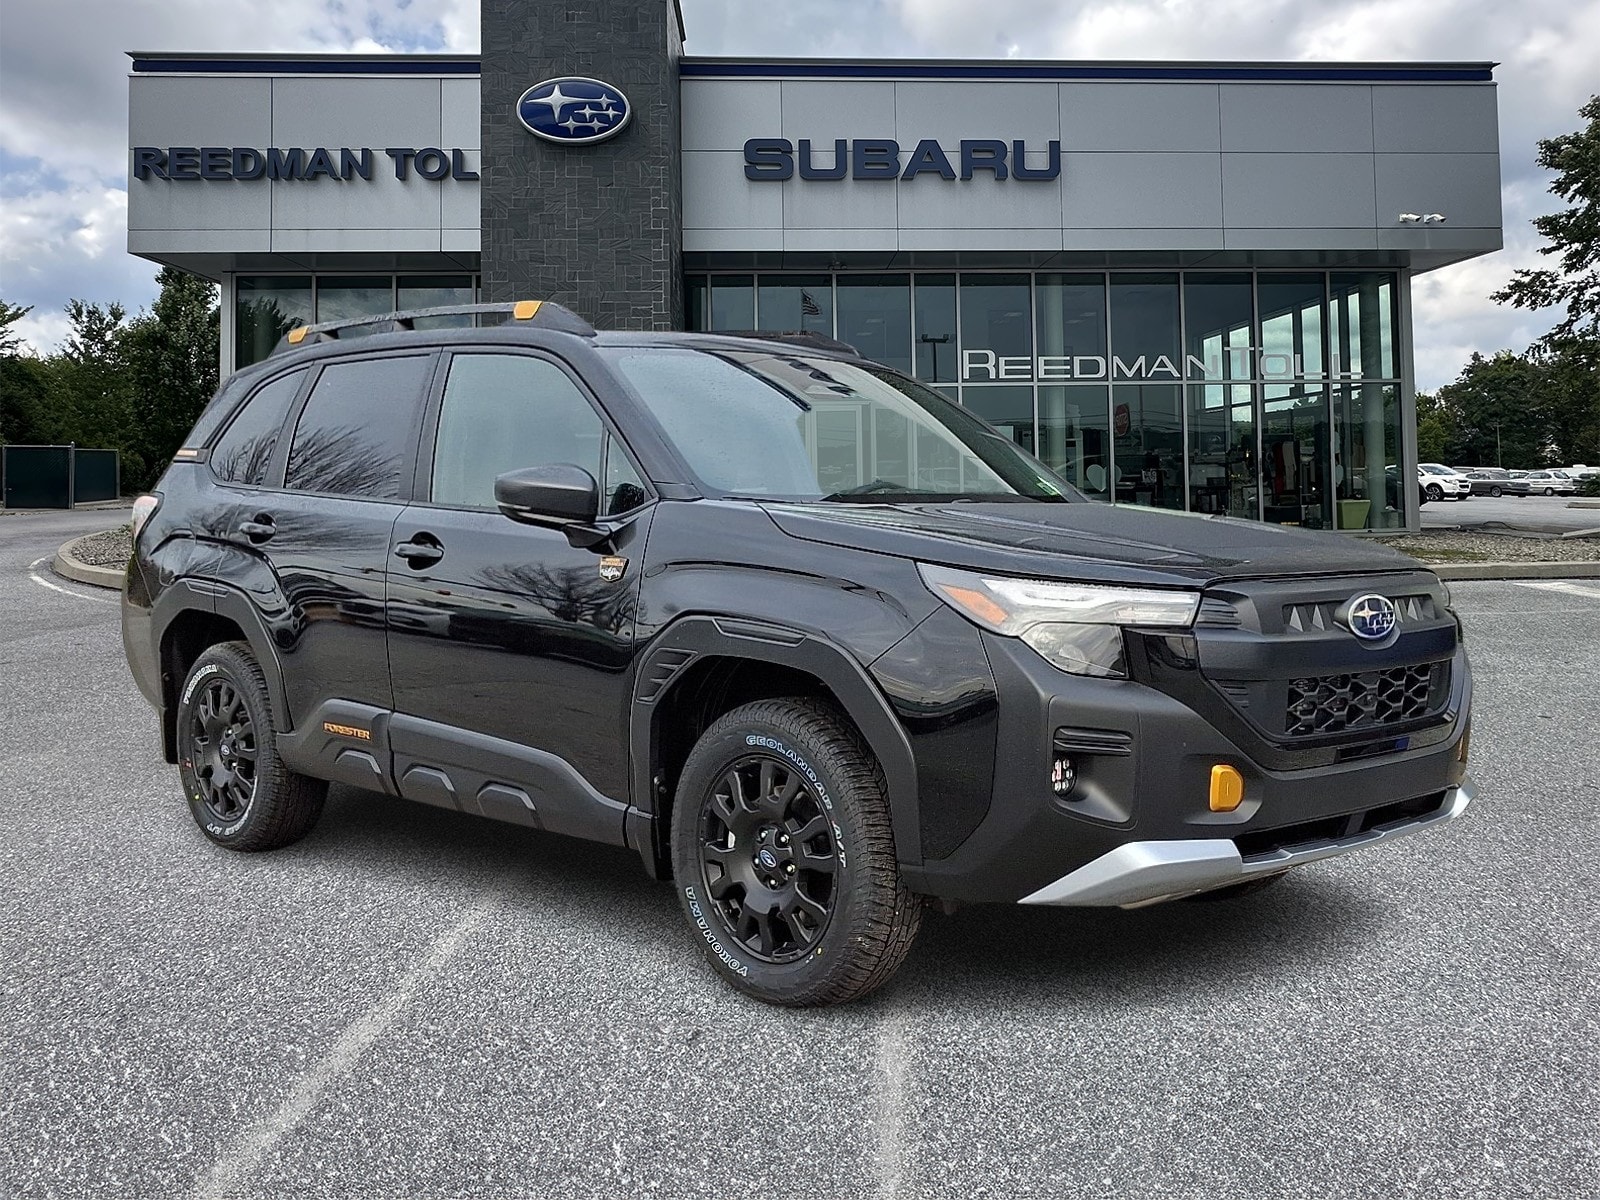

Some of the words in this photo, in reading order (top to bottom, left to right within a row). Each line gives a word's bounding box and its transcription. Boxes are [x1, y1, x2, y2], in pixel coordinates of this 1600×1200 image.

[134, 147, 372, 181] REEDMAN
[744, 138, 1061, 181] SUBARU
[963, 349, 1218, 379] REEDMAN
[1223, 346, 1364, 377] TOLL
[323, 722, 370, 740] FORESTER
[746, 734, 832, 810] GEOLANDAR
[685, 886, 748, 977] YOKOHAMA
